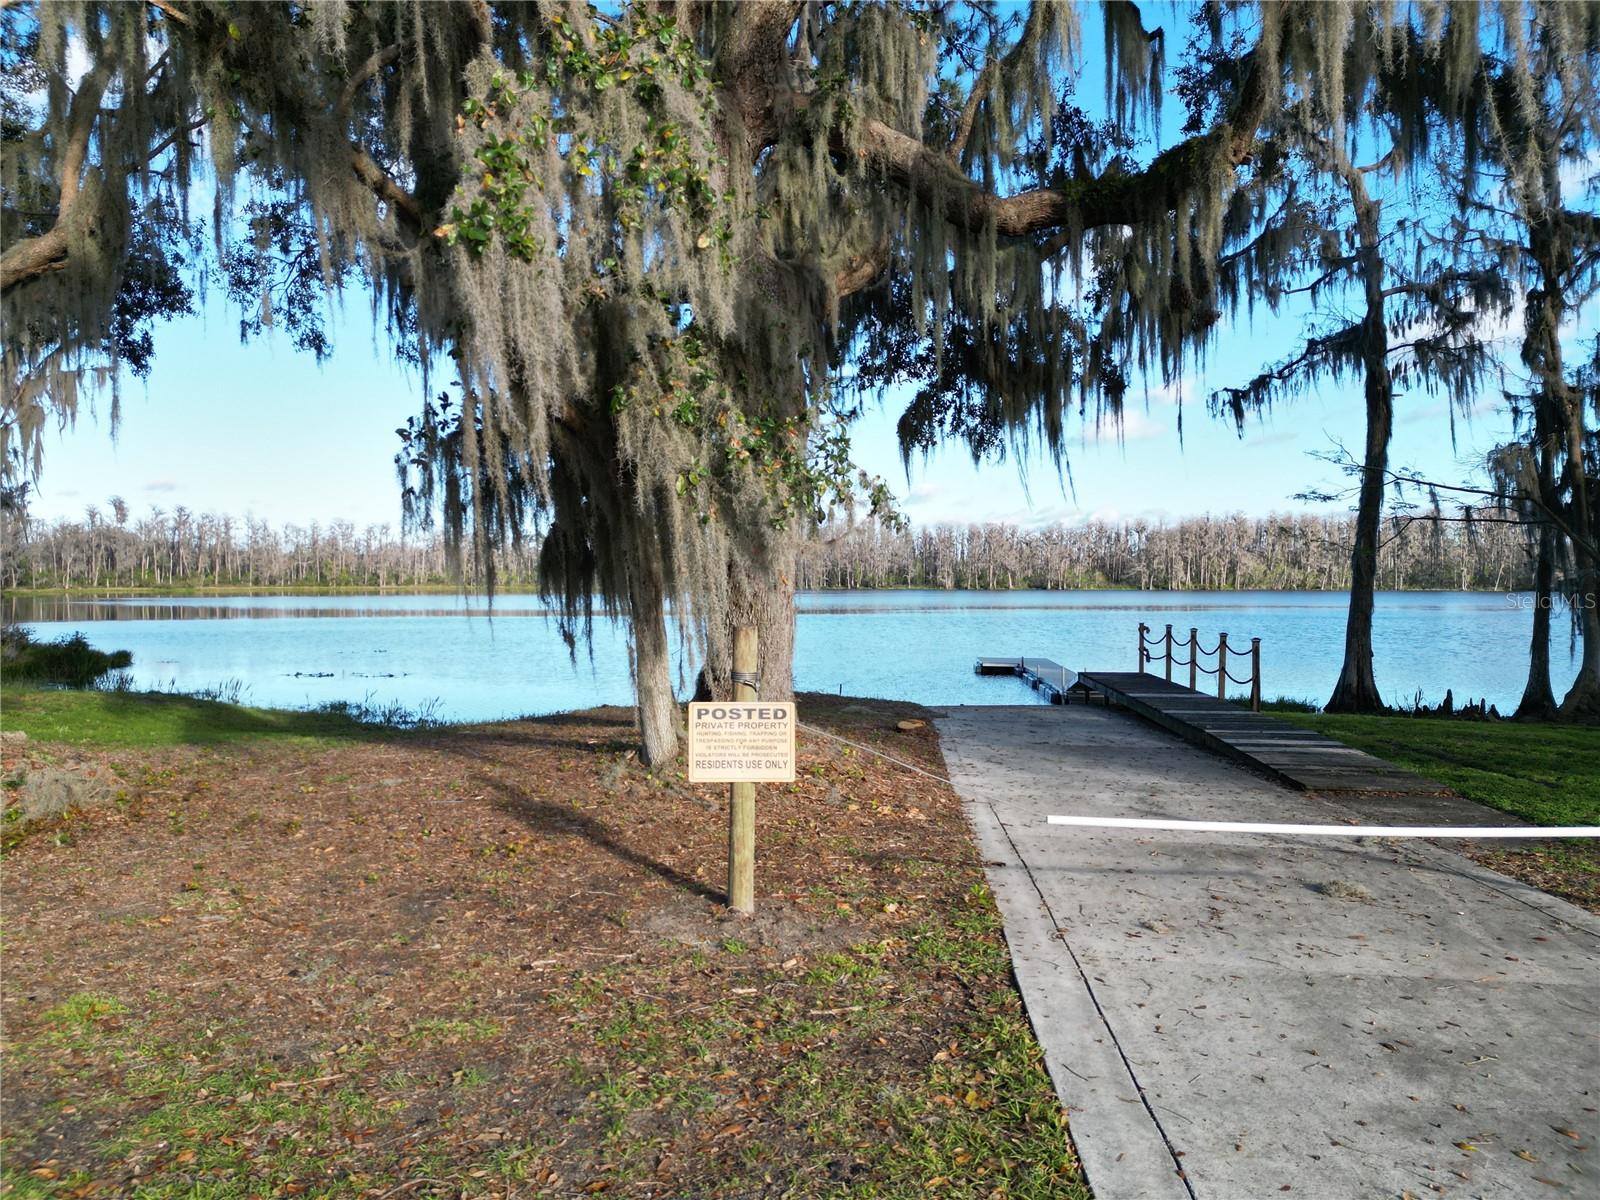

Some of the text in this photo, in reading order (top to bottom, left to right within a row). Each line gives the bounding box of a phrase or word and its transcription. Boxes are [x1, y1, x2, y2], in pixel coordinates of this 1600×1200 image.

[696, 708, 787, 720] POSTED
[695, 760, 788, 769] RESIDENTS USE ONLY
